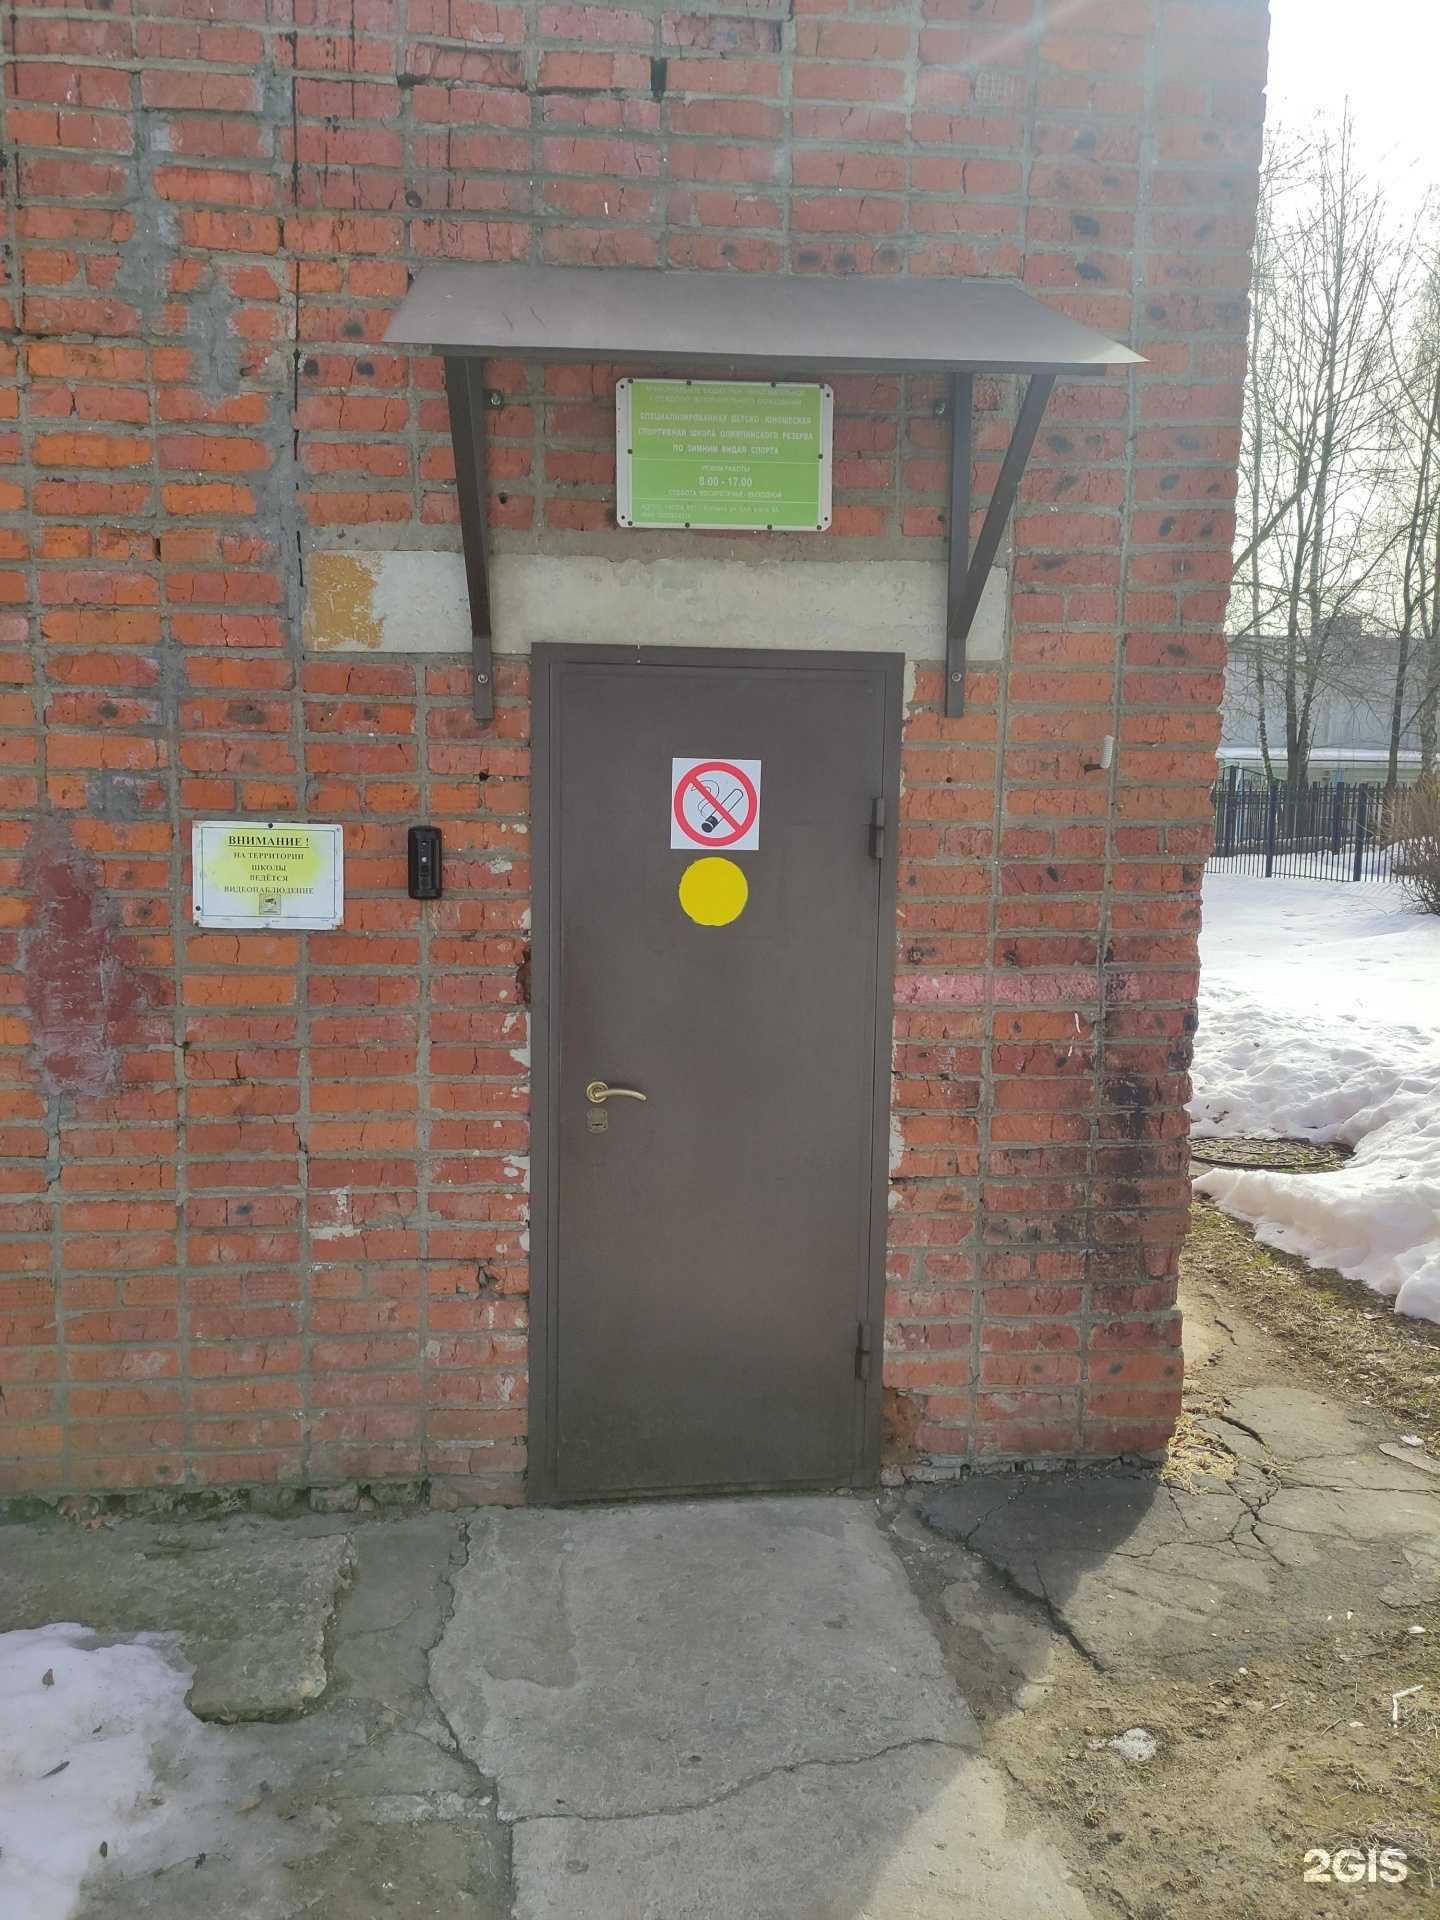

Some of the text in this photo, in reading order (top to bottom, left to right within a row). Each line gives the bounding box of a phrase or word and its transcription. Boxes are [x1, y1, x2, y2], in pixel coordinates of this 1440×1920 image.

[228, 835, 302, 847] ВНИМАНИЕ
[249, 852, 304, 860] ТЕРРИТОРИИ
[251, 864, 287, 872] ШКОЛЫ
[224, 886, 314, 895] ВИДЕОНАБЛЮДЕНИЕ
